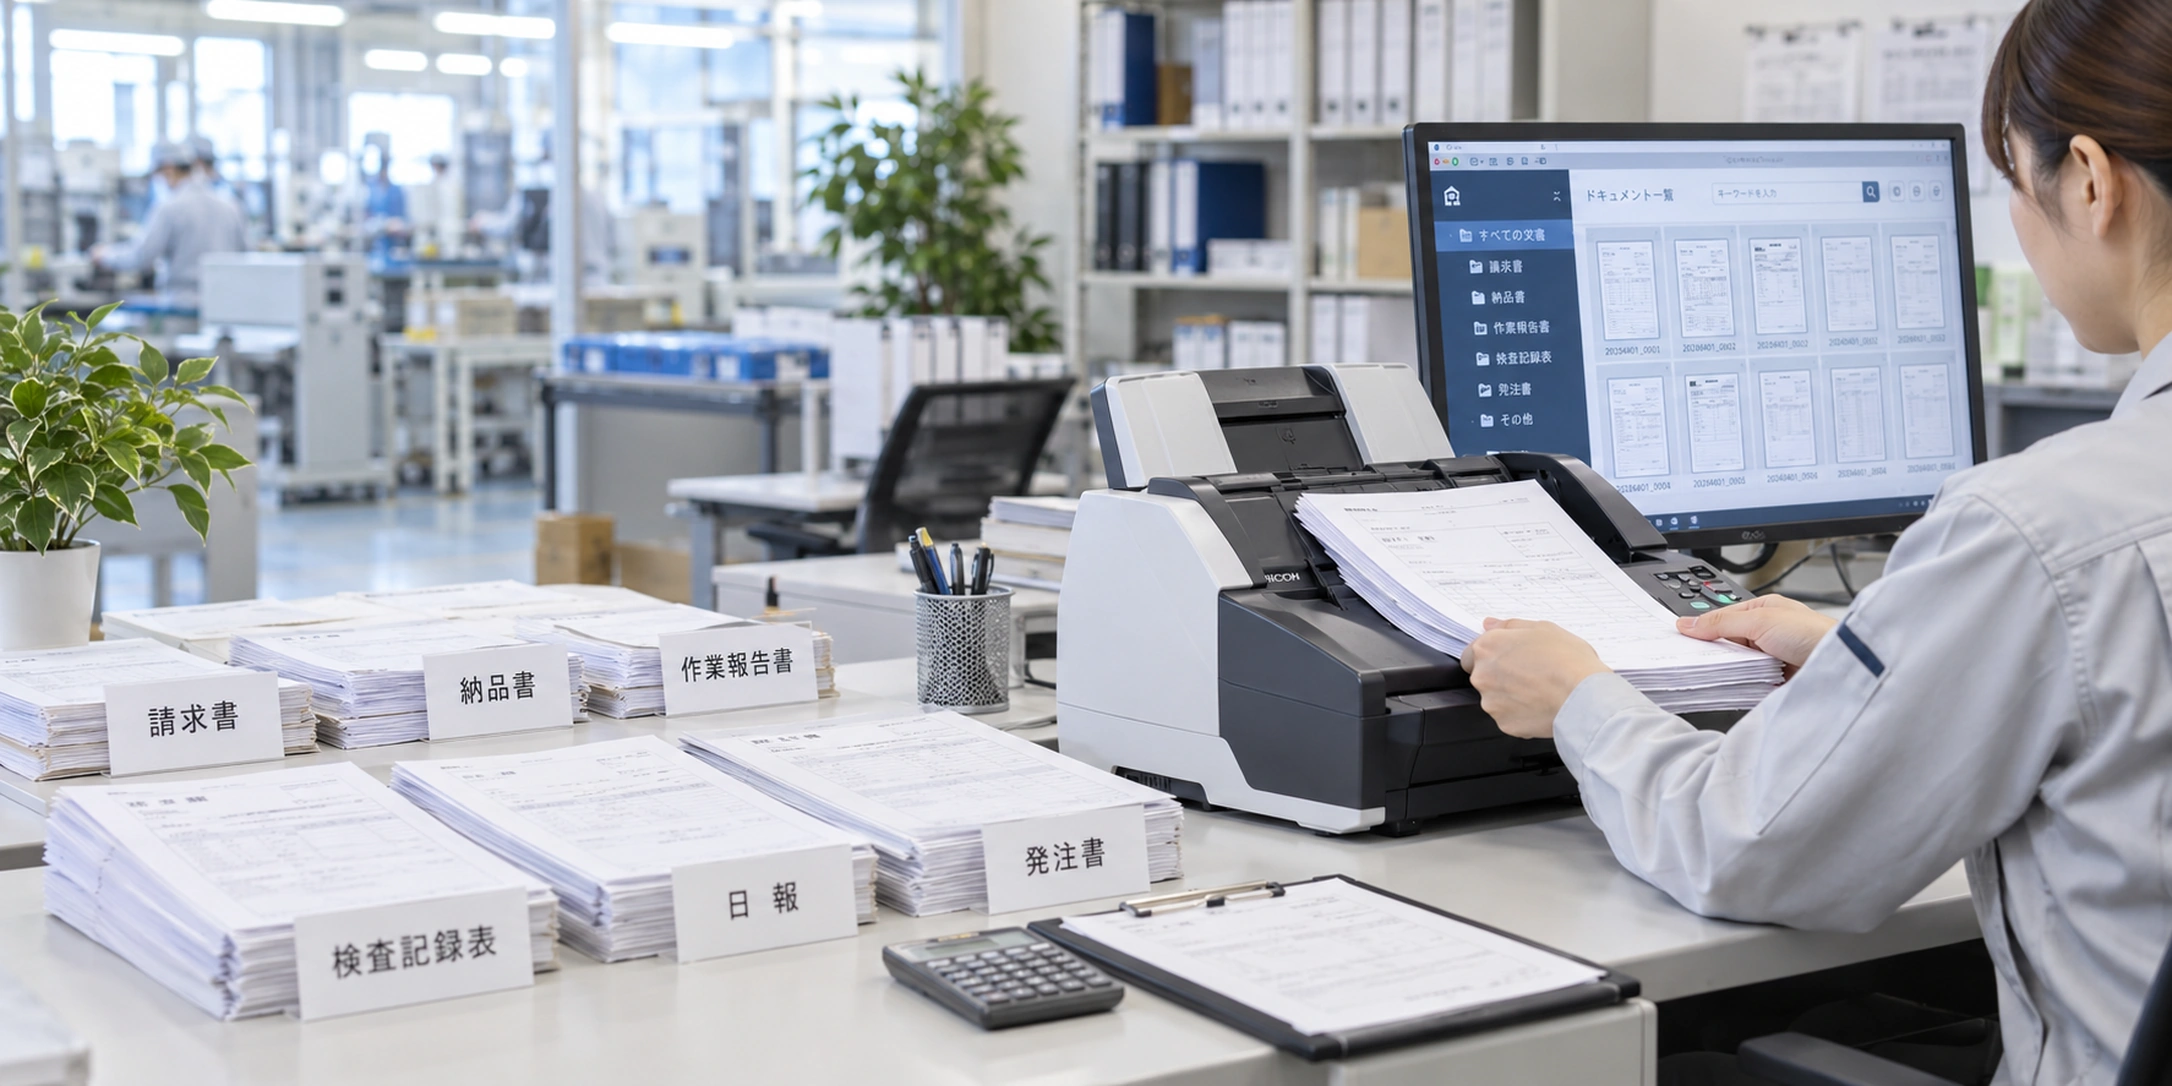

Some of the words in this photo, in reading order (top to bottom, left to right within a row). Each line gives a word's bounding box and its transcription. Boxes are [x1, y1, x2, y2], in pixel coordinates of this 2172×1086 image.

[1500, 412, 1534, 427] その他
[680, 646, 794, 684] 作業報告書
[459, 670, 536, 705] 納品書
[147, 700, 240, 738] 請求書
[1024, 836, 1106, 877] 発注書
[332, 925, 497, 979] 検査記録表
